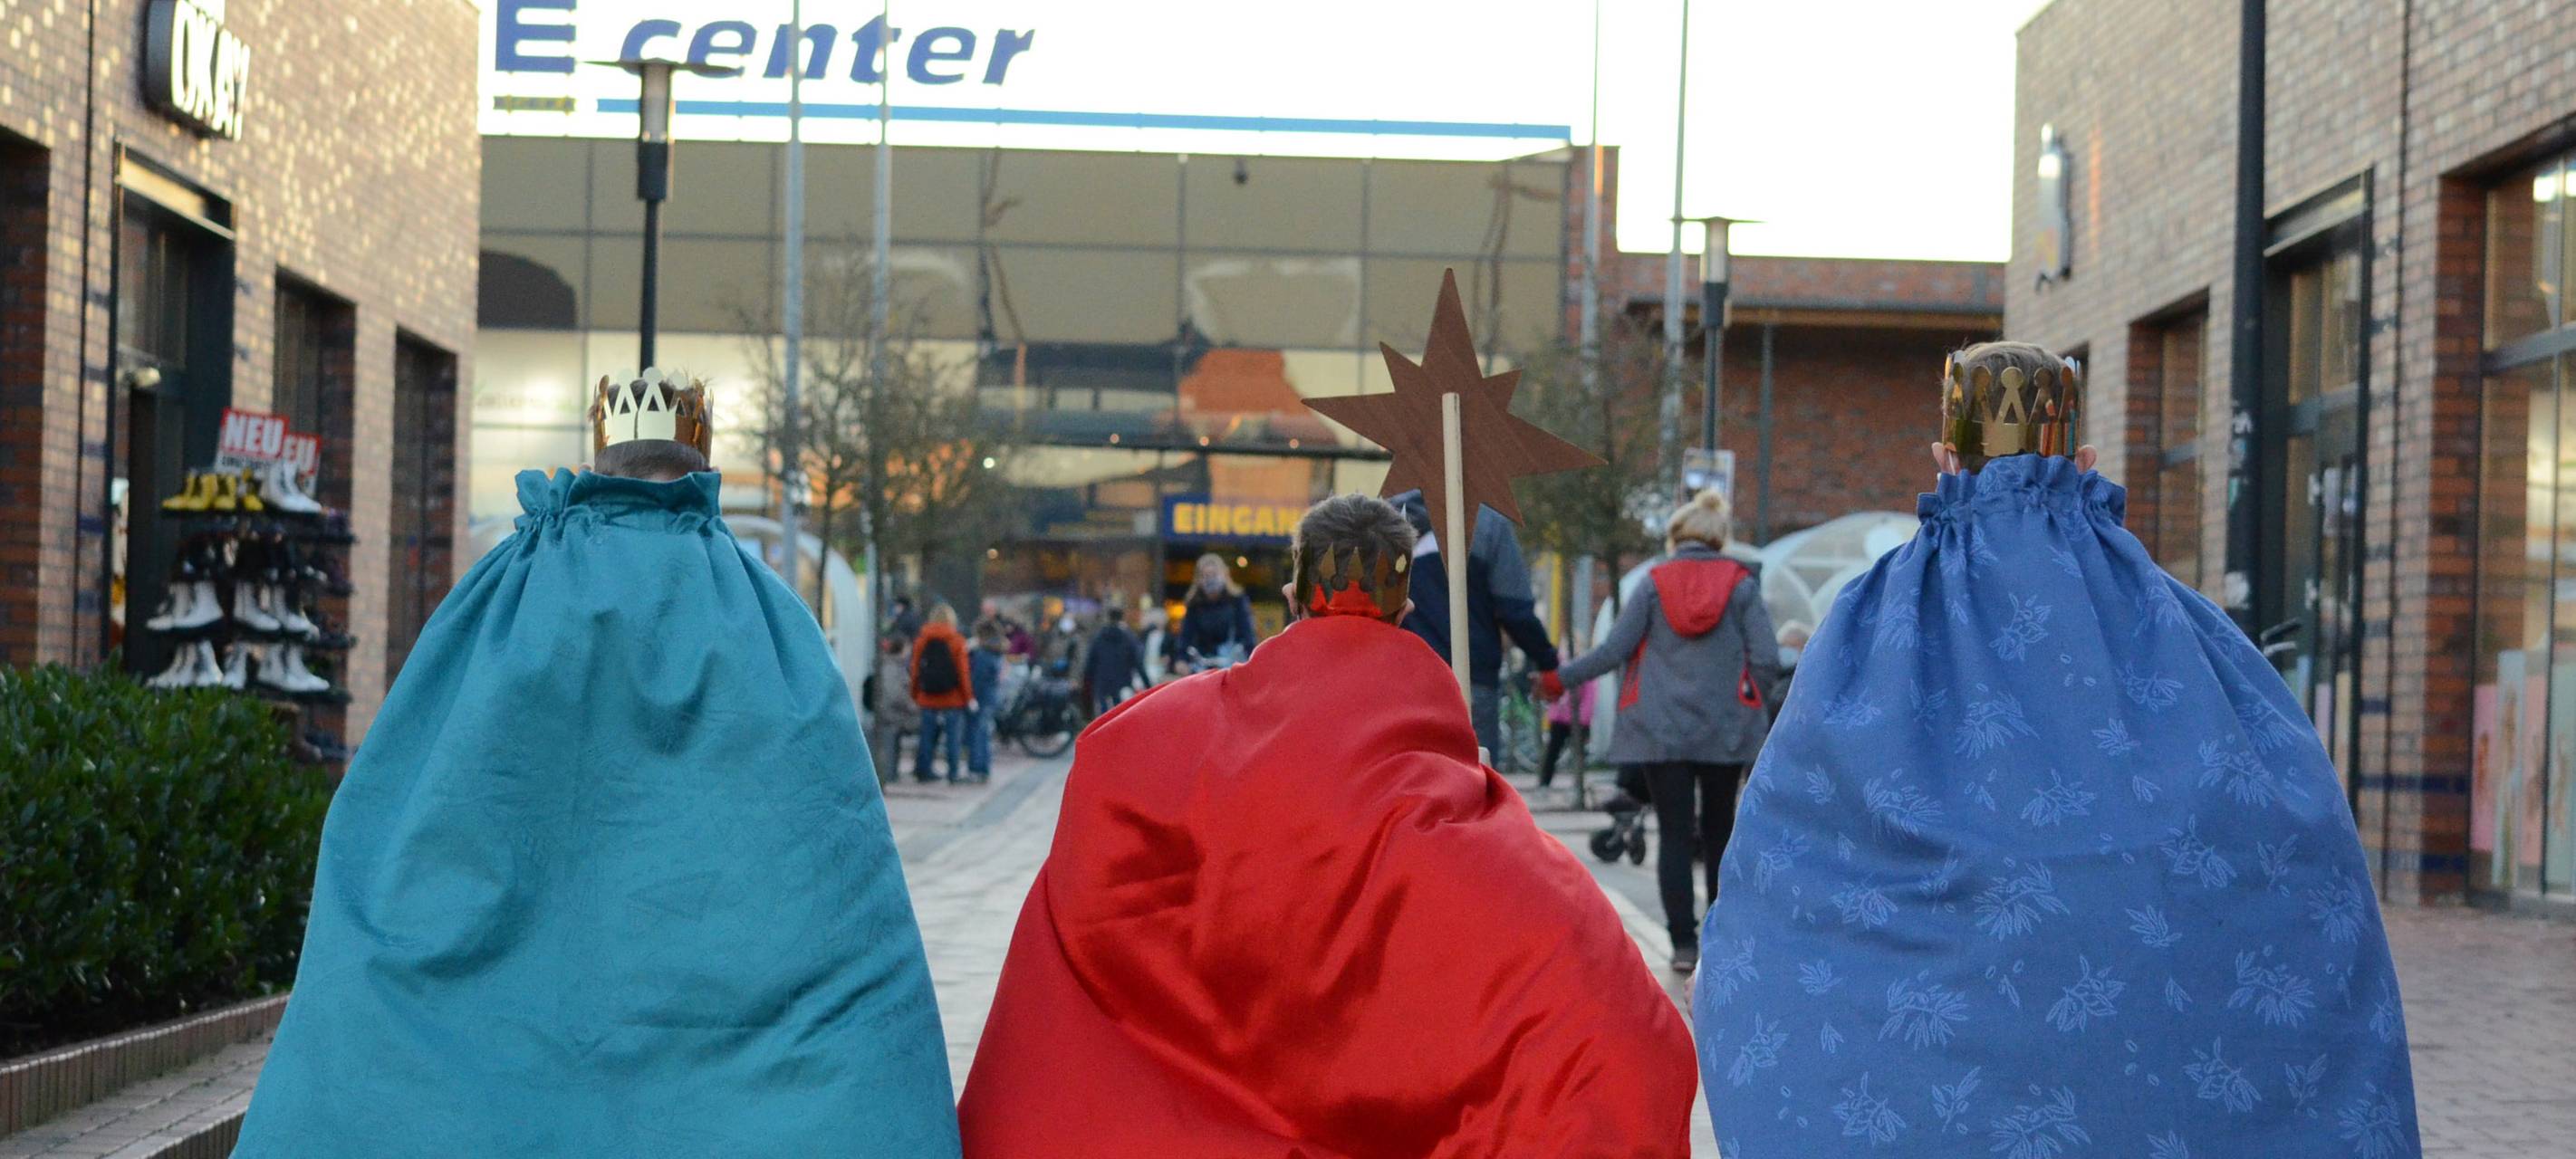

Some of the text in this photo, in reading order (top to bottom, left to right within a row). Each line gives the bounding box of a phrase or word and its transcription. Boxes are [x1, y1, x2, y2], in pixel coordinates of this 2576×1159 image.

[495, 0, 1035, 86] E center
[170, 0, 251, 142] OKAY
[225, 413, 284, 455] NEU
[282, 435, 316, 473] EU
[1174, 503, 1302, 536] EINGAN
